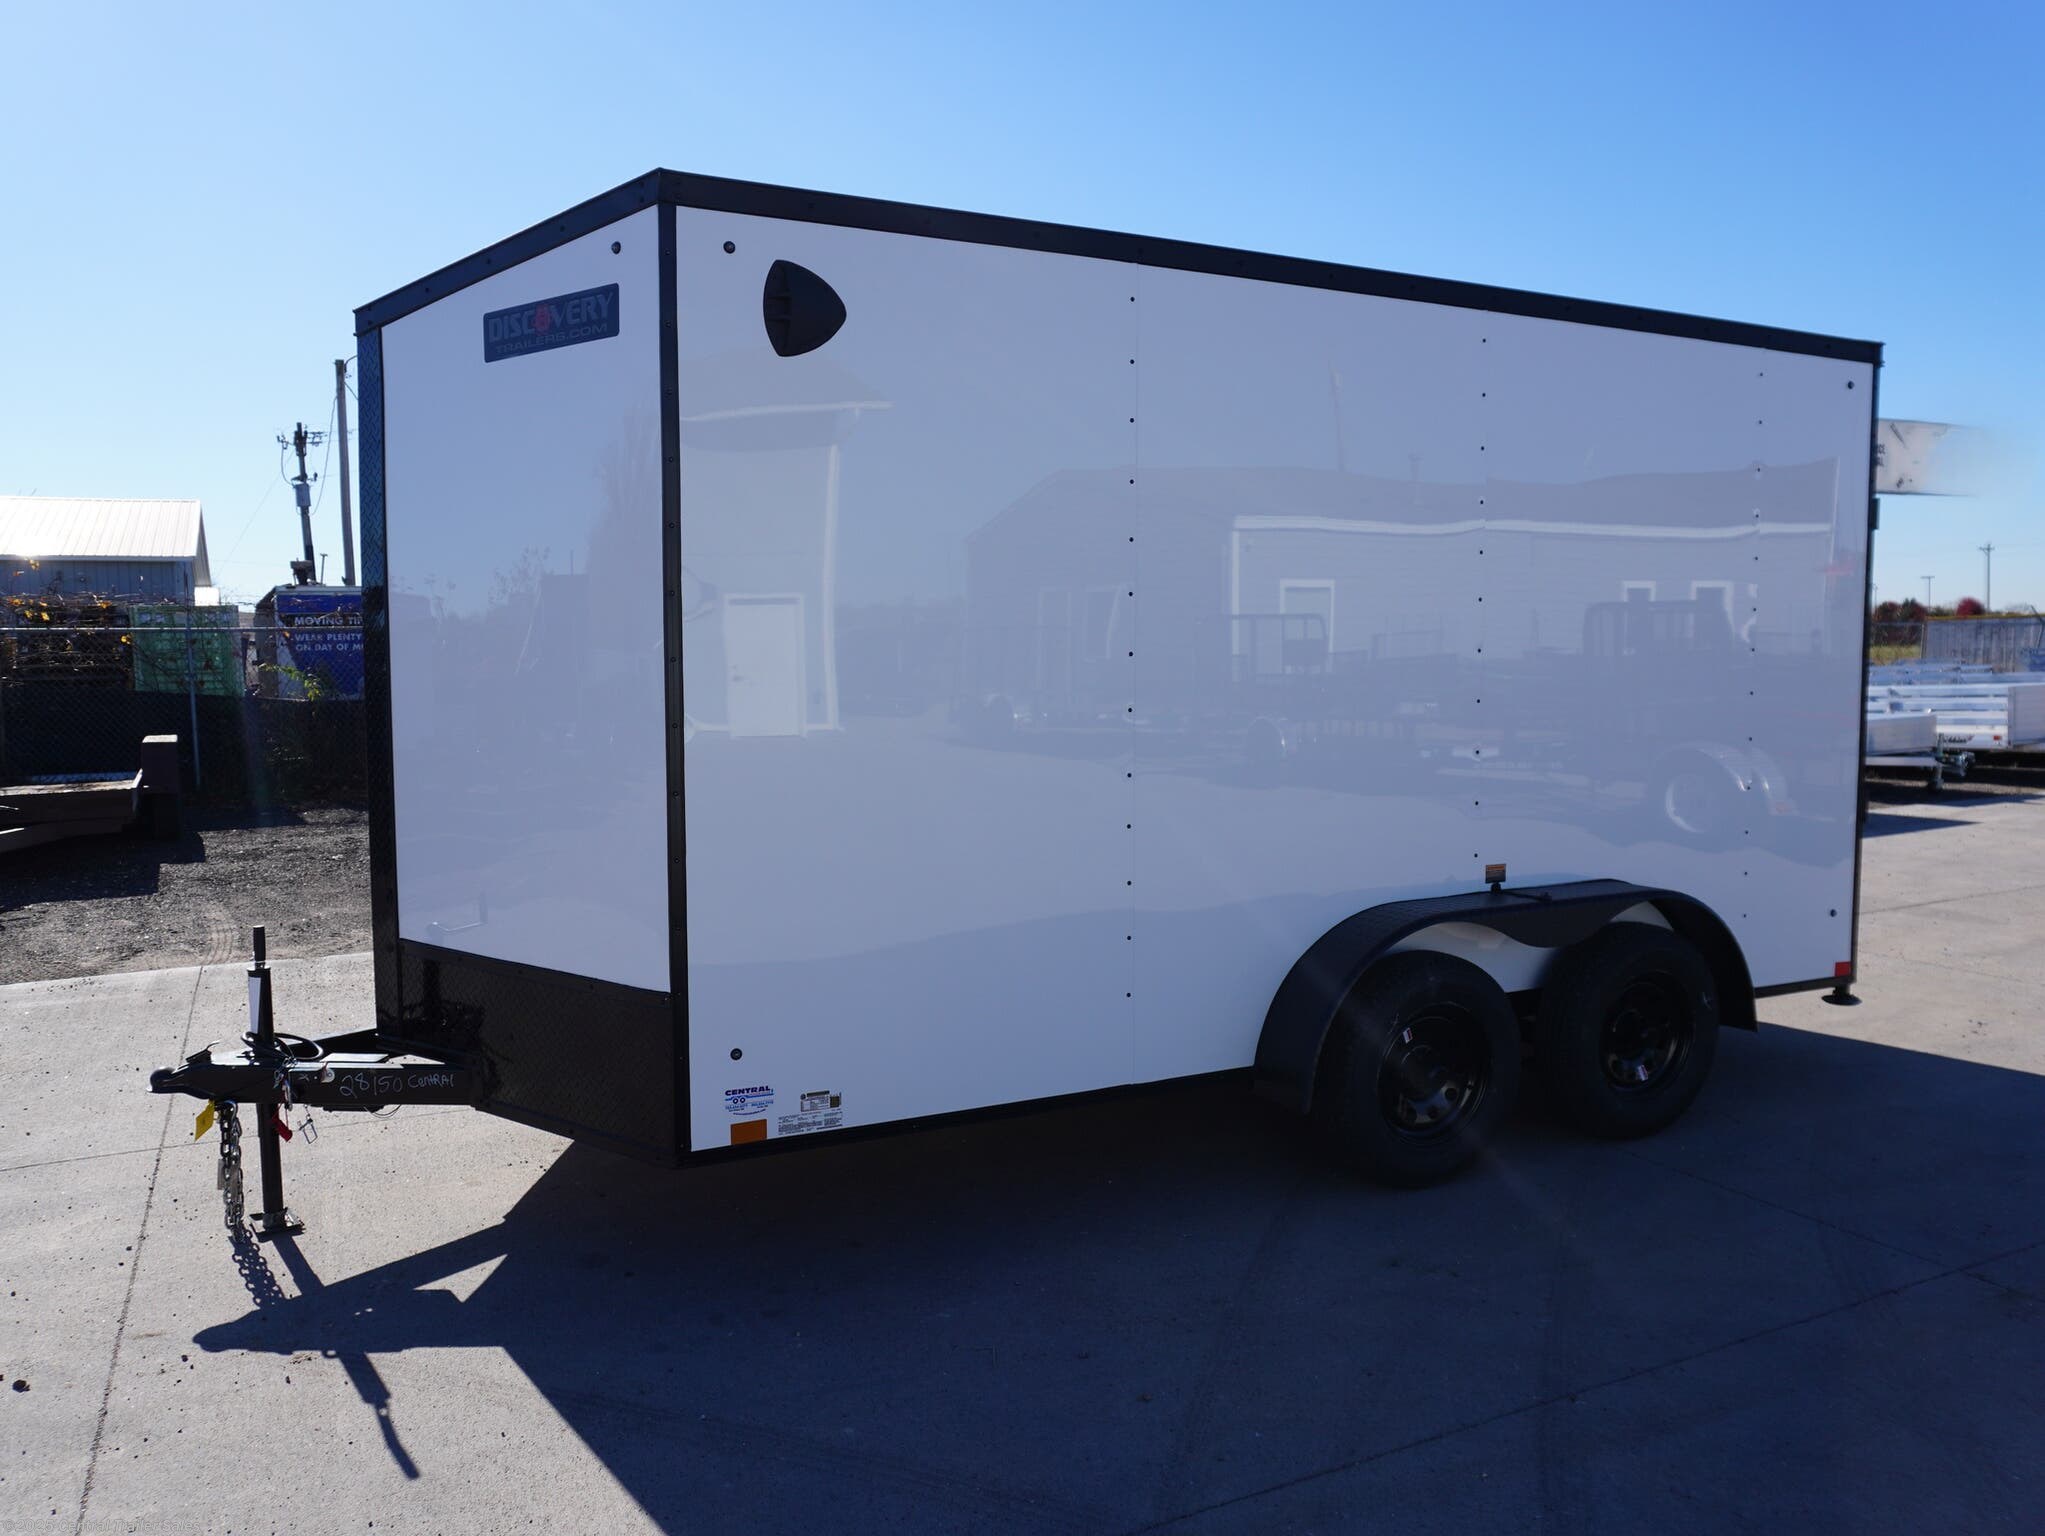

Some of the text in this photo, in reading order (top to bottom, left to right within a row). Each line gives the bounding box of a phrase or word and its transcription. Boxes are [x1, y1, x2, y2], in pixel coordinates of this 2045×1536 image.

[488, 291, 614, 343] DISCOVERY
[496, 323, 608, 354] TRAILERS.COM
[295, 616, 343, 625] MOVING
[327, 633, 361, 641] PLENTY
[315, 643, 332, 651] DAY
[340, 1072, 403, 1098] 28150
[725, 1085, 770, 1096] CENTRAL
